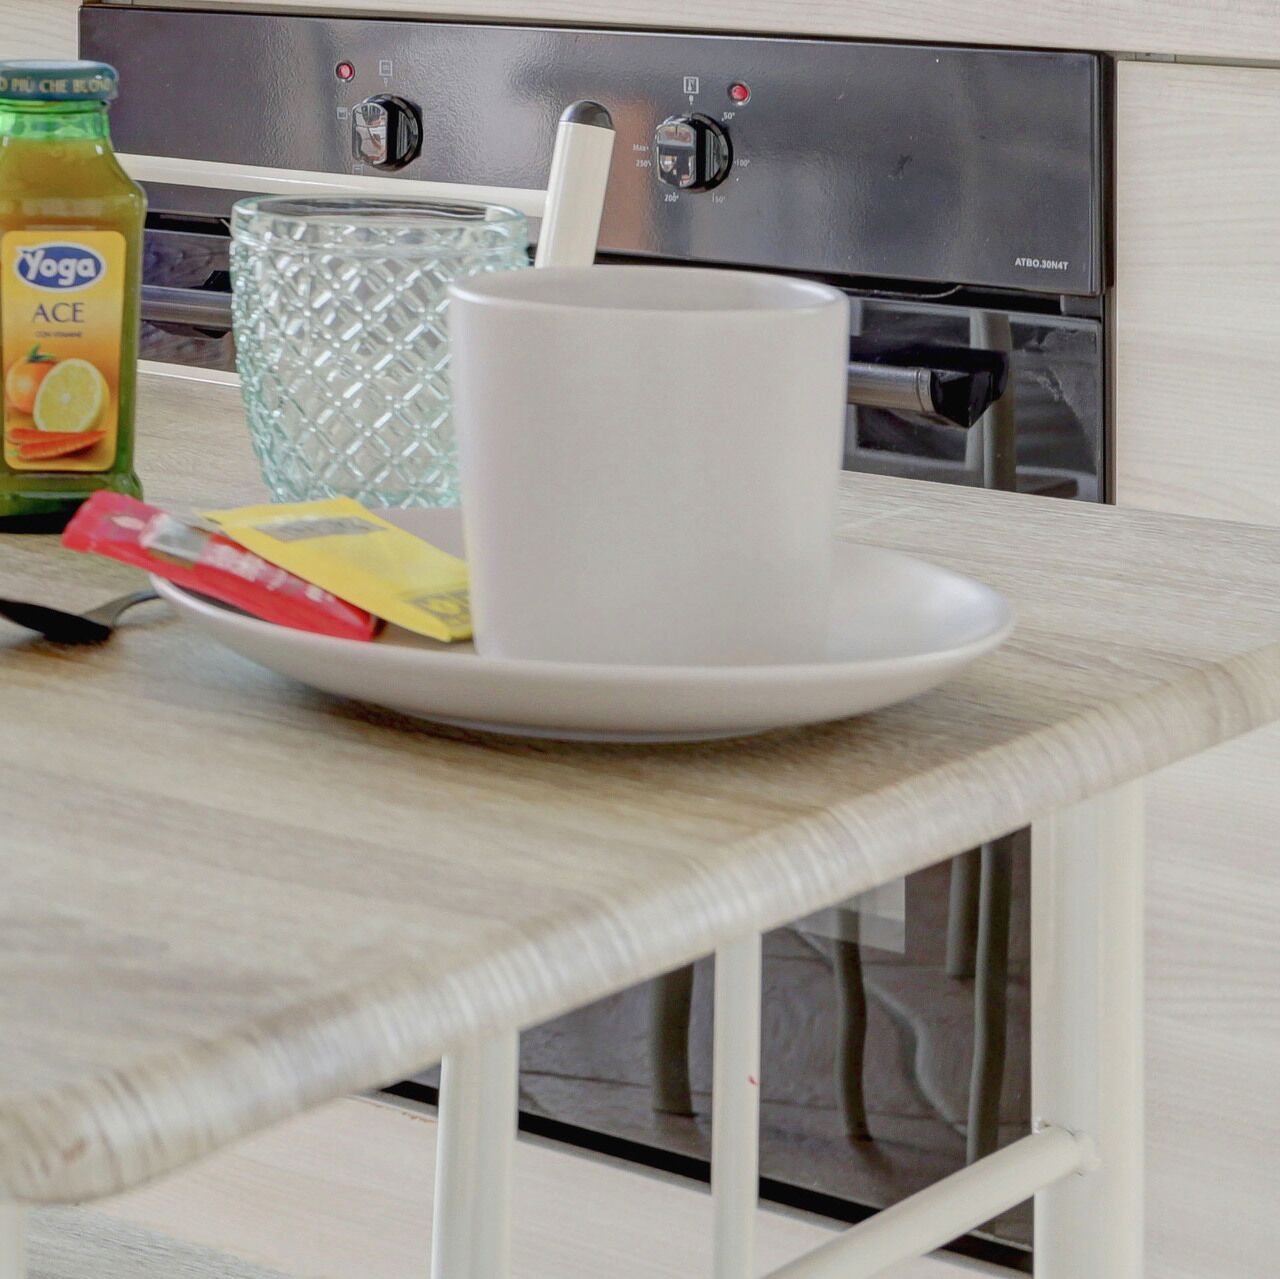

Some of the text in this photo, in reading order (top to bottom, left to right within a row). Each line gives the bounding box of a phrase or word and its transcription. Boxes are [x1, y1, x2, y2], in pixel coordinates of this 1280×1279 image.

[38, 78, 70, 93] CHE
[20, 249, 96, 286] Yoga
[32, 302, 85, 324] ACE
